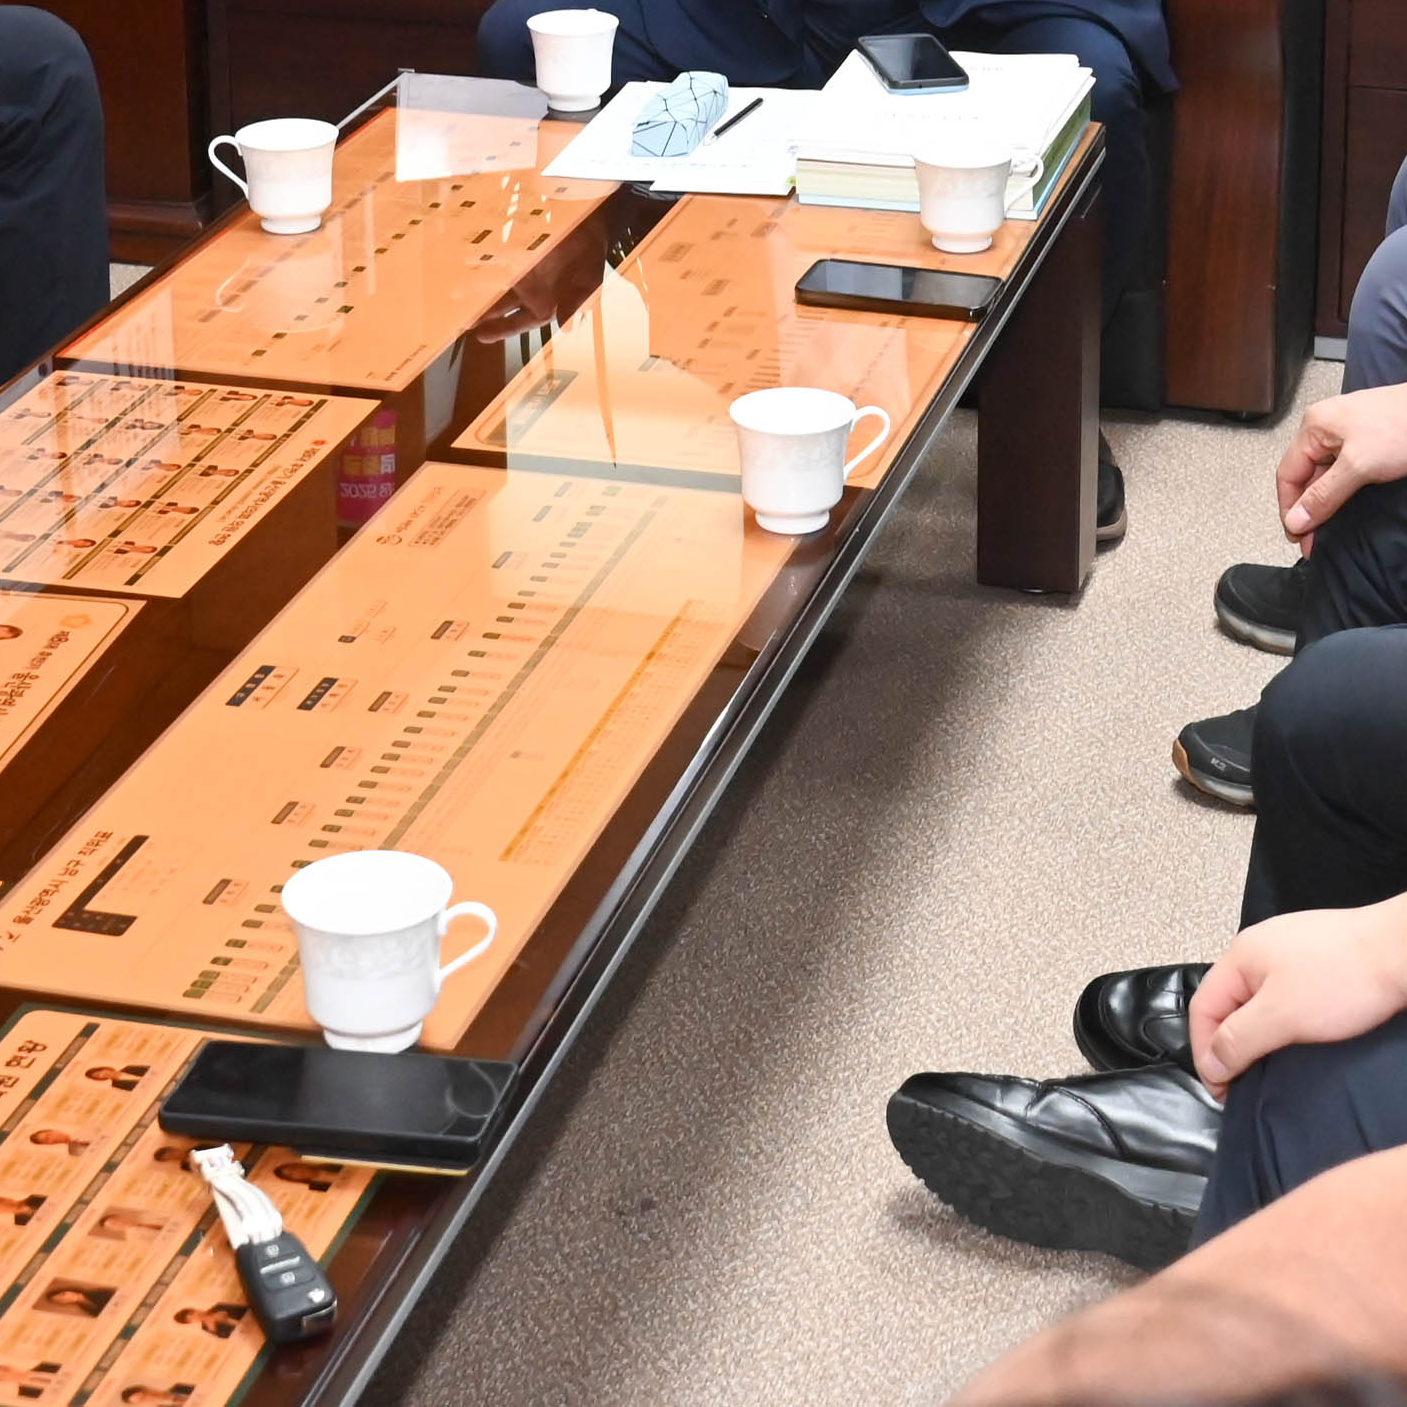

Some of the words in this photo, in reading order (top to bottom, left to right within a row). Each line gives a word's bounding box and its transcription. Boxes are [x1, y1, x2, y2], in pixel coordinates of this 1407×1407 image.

[13, 879, 69, 925] 울산광역시
[58, 859, 85, 876] 남구
[6, 1040, 48, 1069] 현황
